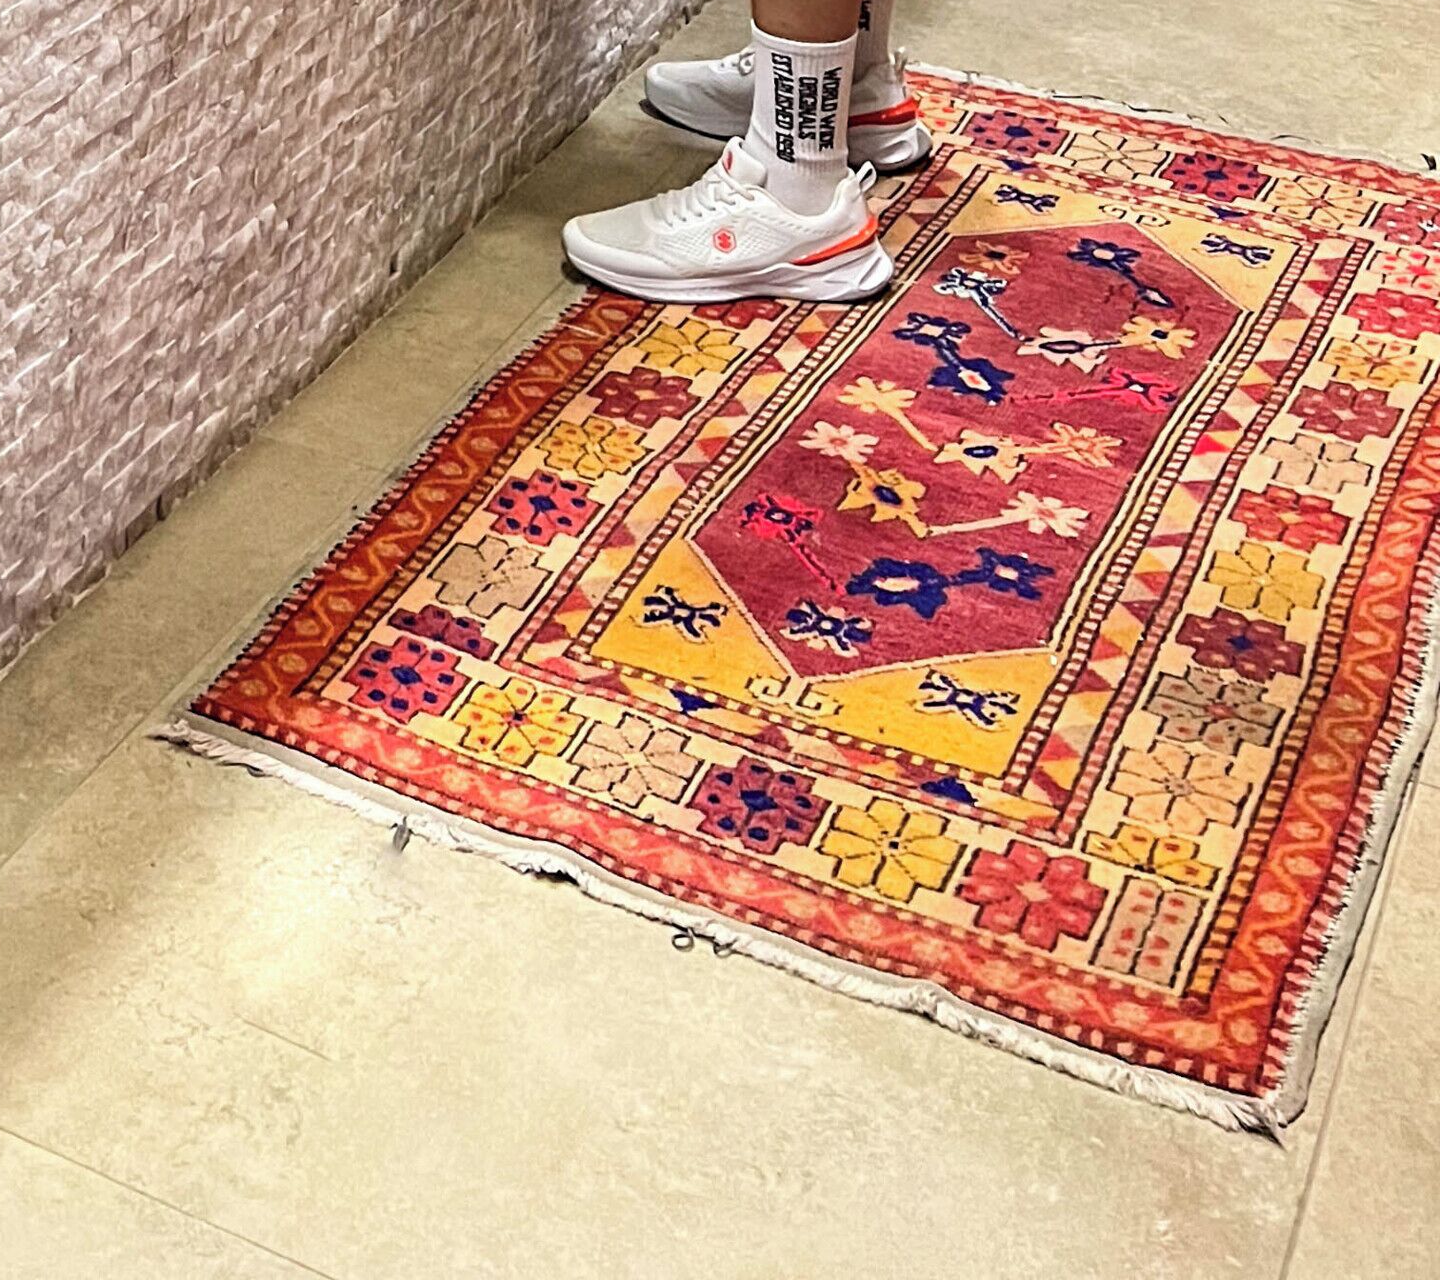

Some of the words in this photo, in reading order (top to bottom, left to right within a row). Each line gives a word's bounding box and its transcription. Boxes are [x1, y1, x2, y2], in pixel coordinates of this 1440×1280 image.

[798, 76, 818, 140] ORIGINALS
[821, 67, 842, 112] WORLD
[819, 114, 837, 151] WIDE
